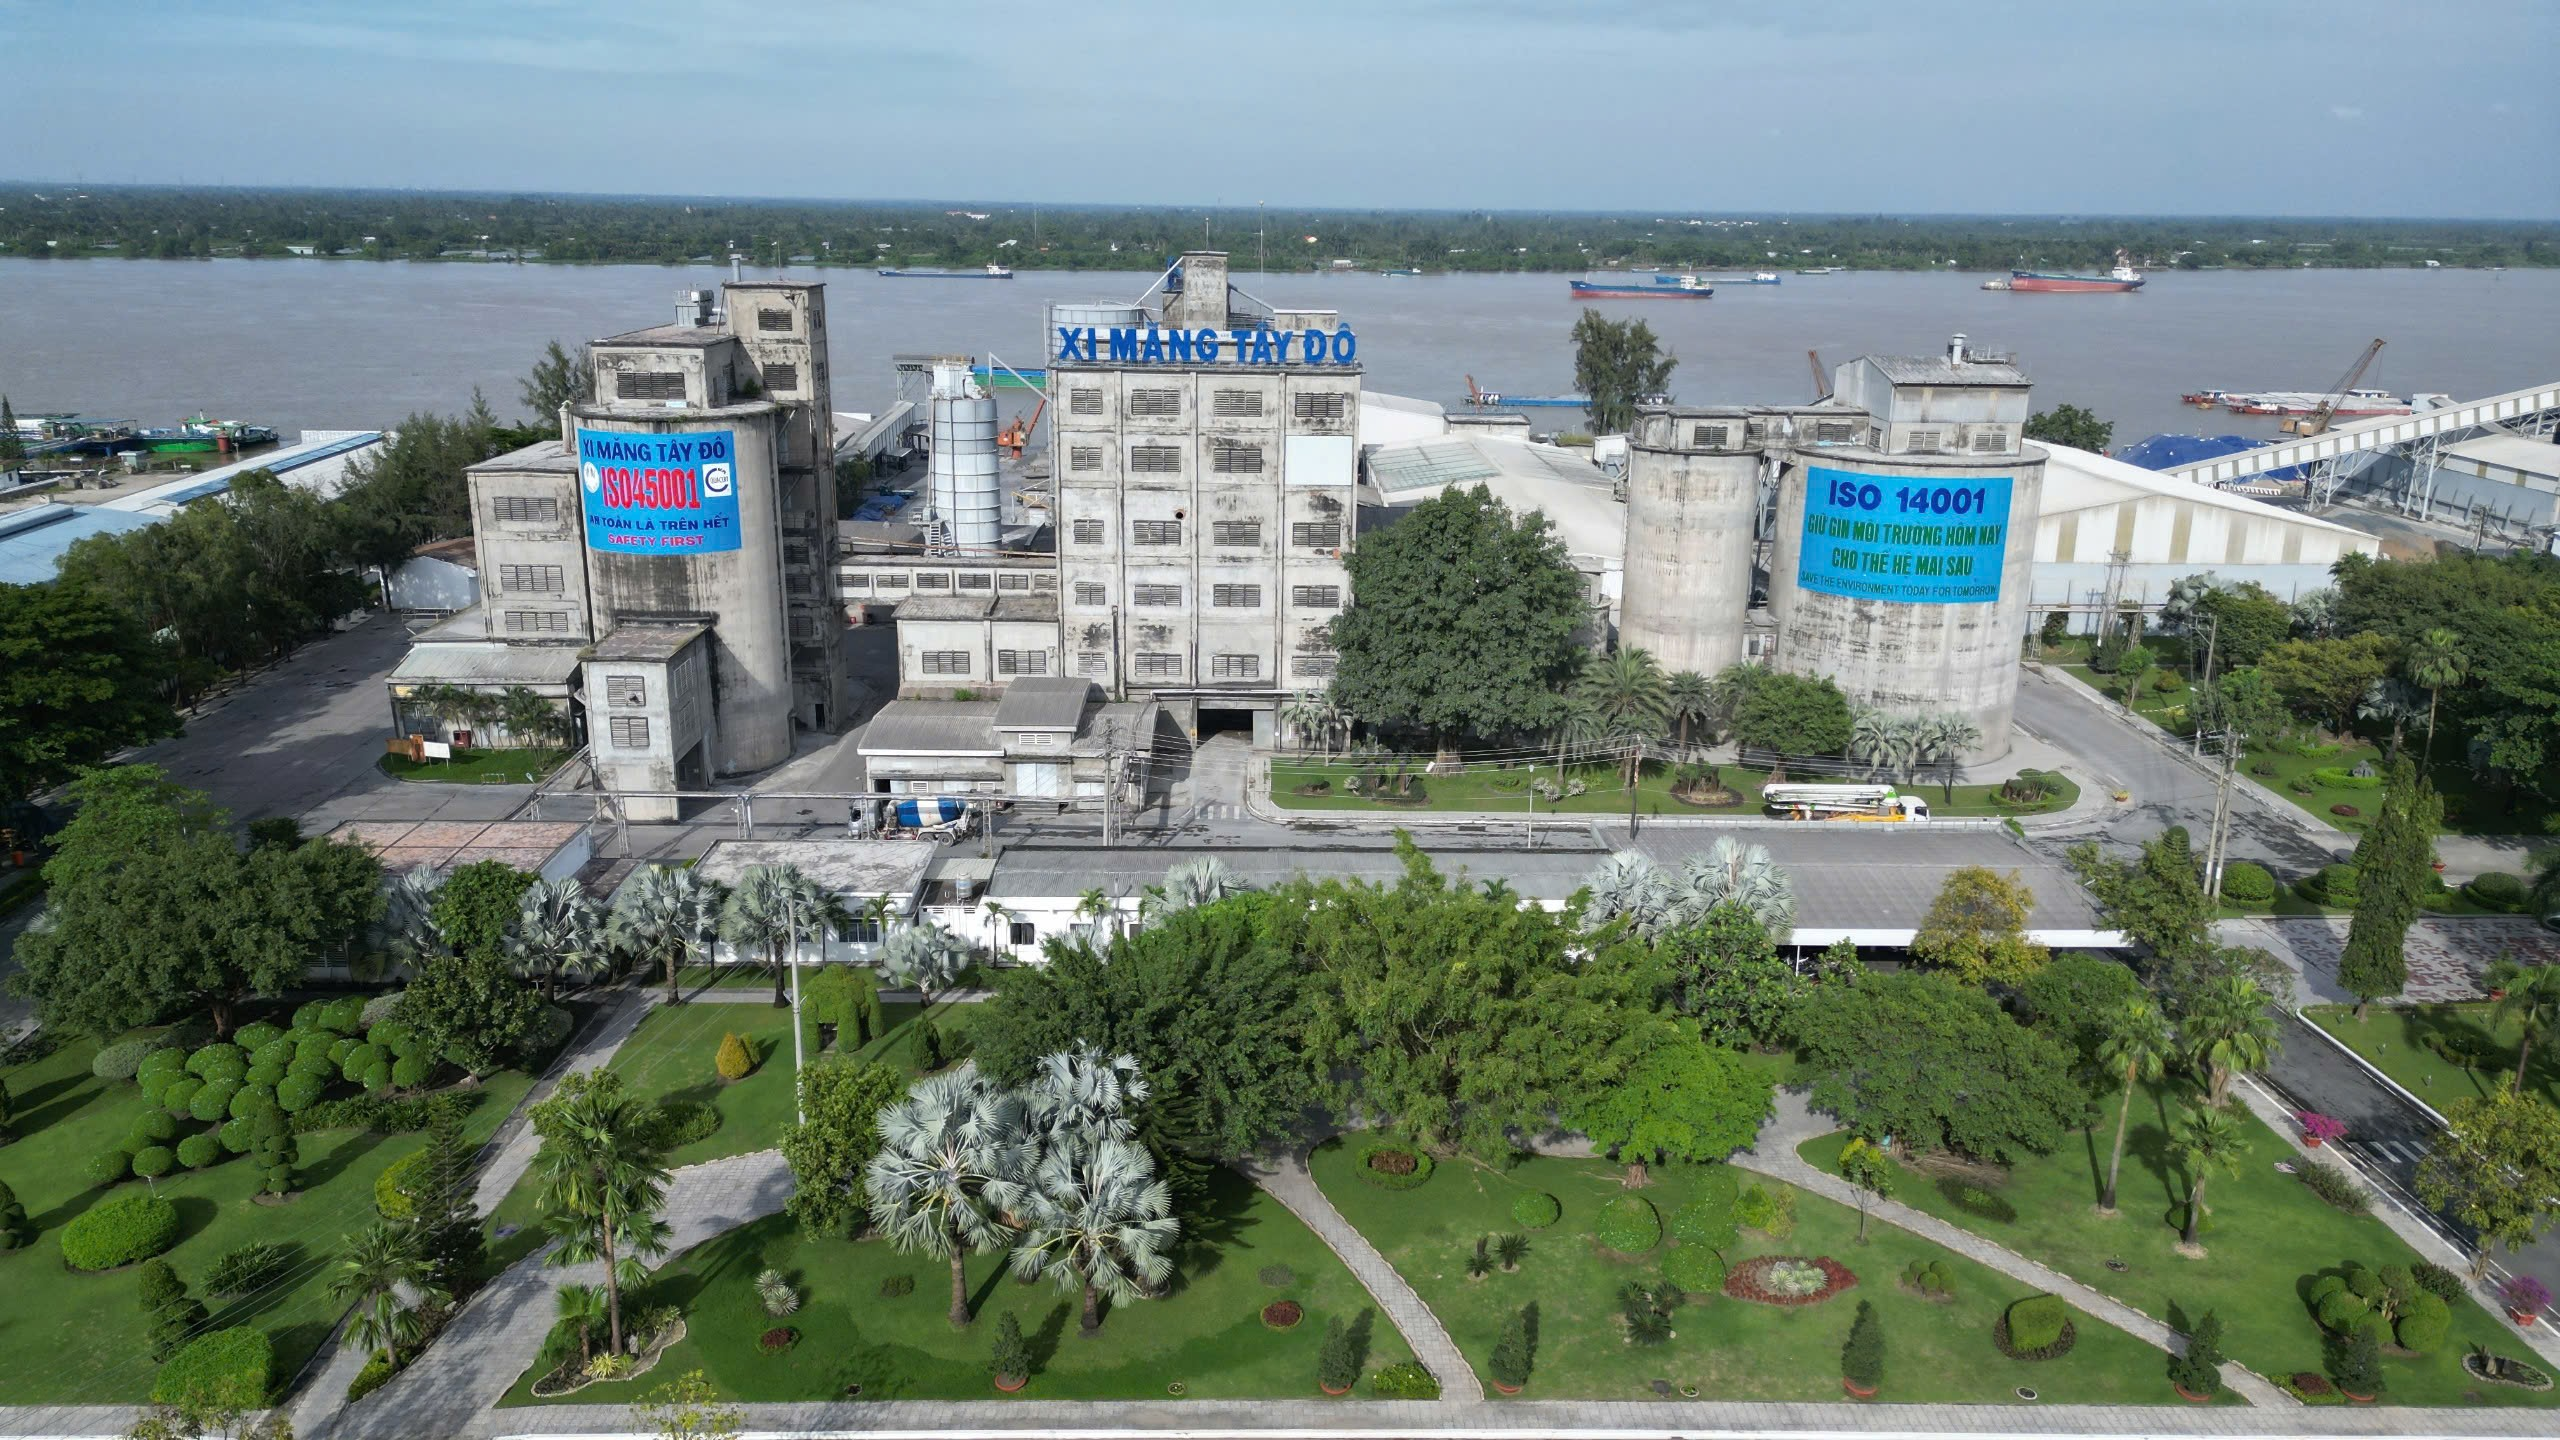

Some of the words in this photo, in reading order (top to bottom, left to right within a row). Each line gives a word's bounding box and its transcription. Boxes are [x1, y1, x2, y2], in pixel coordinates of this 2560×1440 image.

[1057, 326, 1097, 361] XI
[1109, 321, 1219, 364] MĂNG
[1231, 322, 1294, 365] TÂY
[1303, 322, 1357, 366] ĐÔ
[583, 438, 594, 458] XI
[597, 437, 652, 462] MĂNG
[655, 439, 693, 463] TÂY
[698, 436, 726, 460] ĐÔ
[600, 466, 702, 510] ISO45001
[1828, 479, 1882, 511] ISO
[1895, 486, 1986, 515] 14001
[602, 515, 632, 529] TOÀN
[636, 518, 655, 531] LÀ
[659, 517, 699, 531] TRÊN
[703, 511, 729, 528] HẾT
[1945, 522, 1976, 547] HÔM
[1978, 524, 2002, 546] NAY
[608, 534, 656, 546] SAFETY
[661, 535, 705, 547] FIRST
[1832, 547, 1858, 570] CHO
[1915, 555, 1943, 576] MAI
[1946, 555, 1974, 576] SAU
[1800, 571, 1818, 585] SAVE
[1820, 576, 1835, 588] THE
[1837, 578, 1899, 595] ENVIRONMENT
[1901, 585, 1929, 597] TODAY
[1932, 585, 1951, 597] FOR
[1953, 584, 1997, 597] TOMORROW
